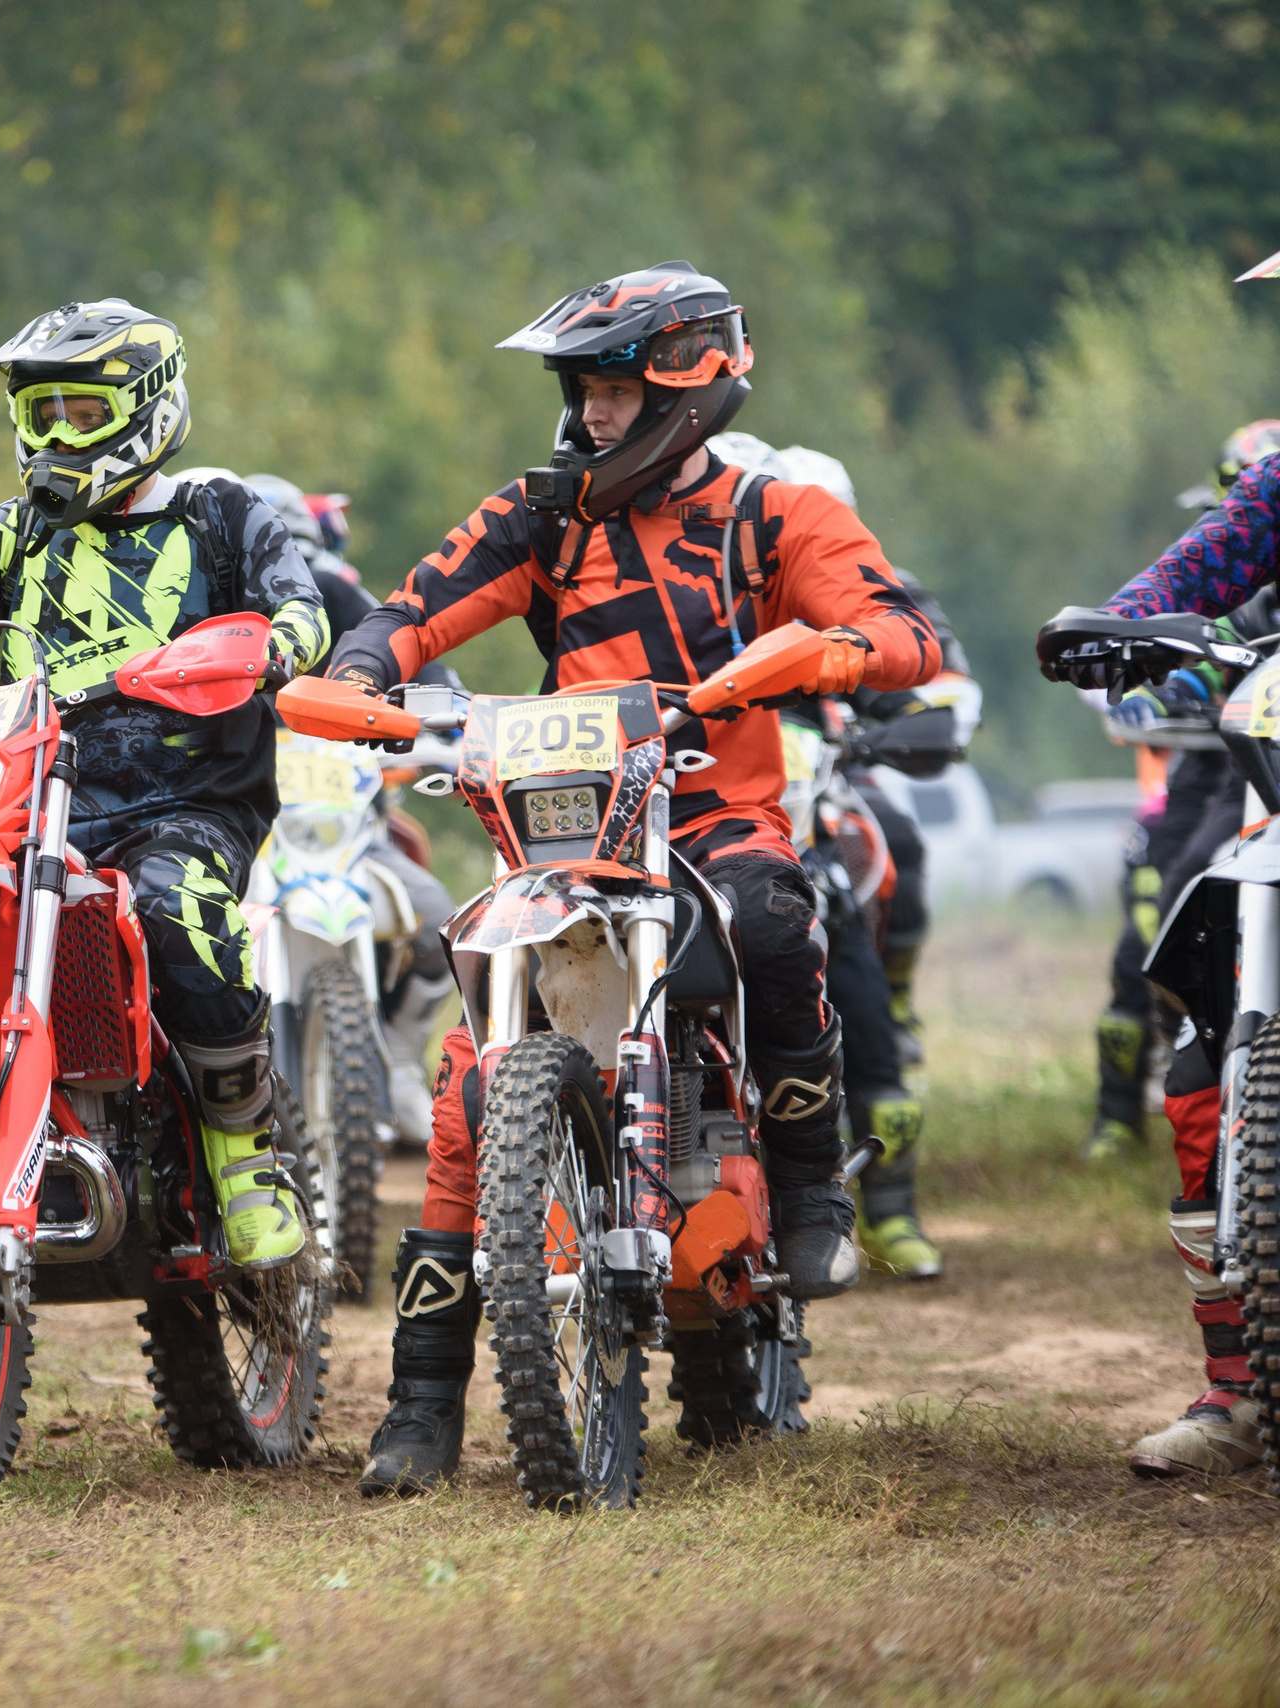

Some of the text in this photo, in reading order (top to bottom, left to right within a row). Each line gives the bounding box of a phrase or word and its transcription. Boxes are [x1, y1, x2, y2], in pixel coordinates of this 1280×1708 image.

[498, 698, 617, 719] КУКУШКИН ОВРАГ
[506, 712, 605, 760] 205
